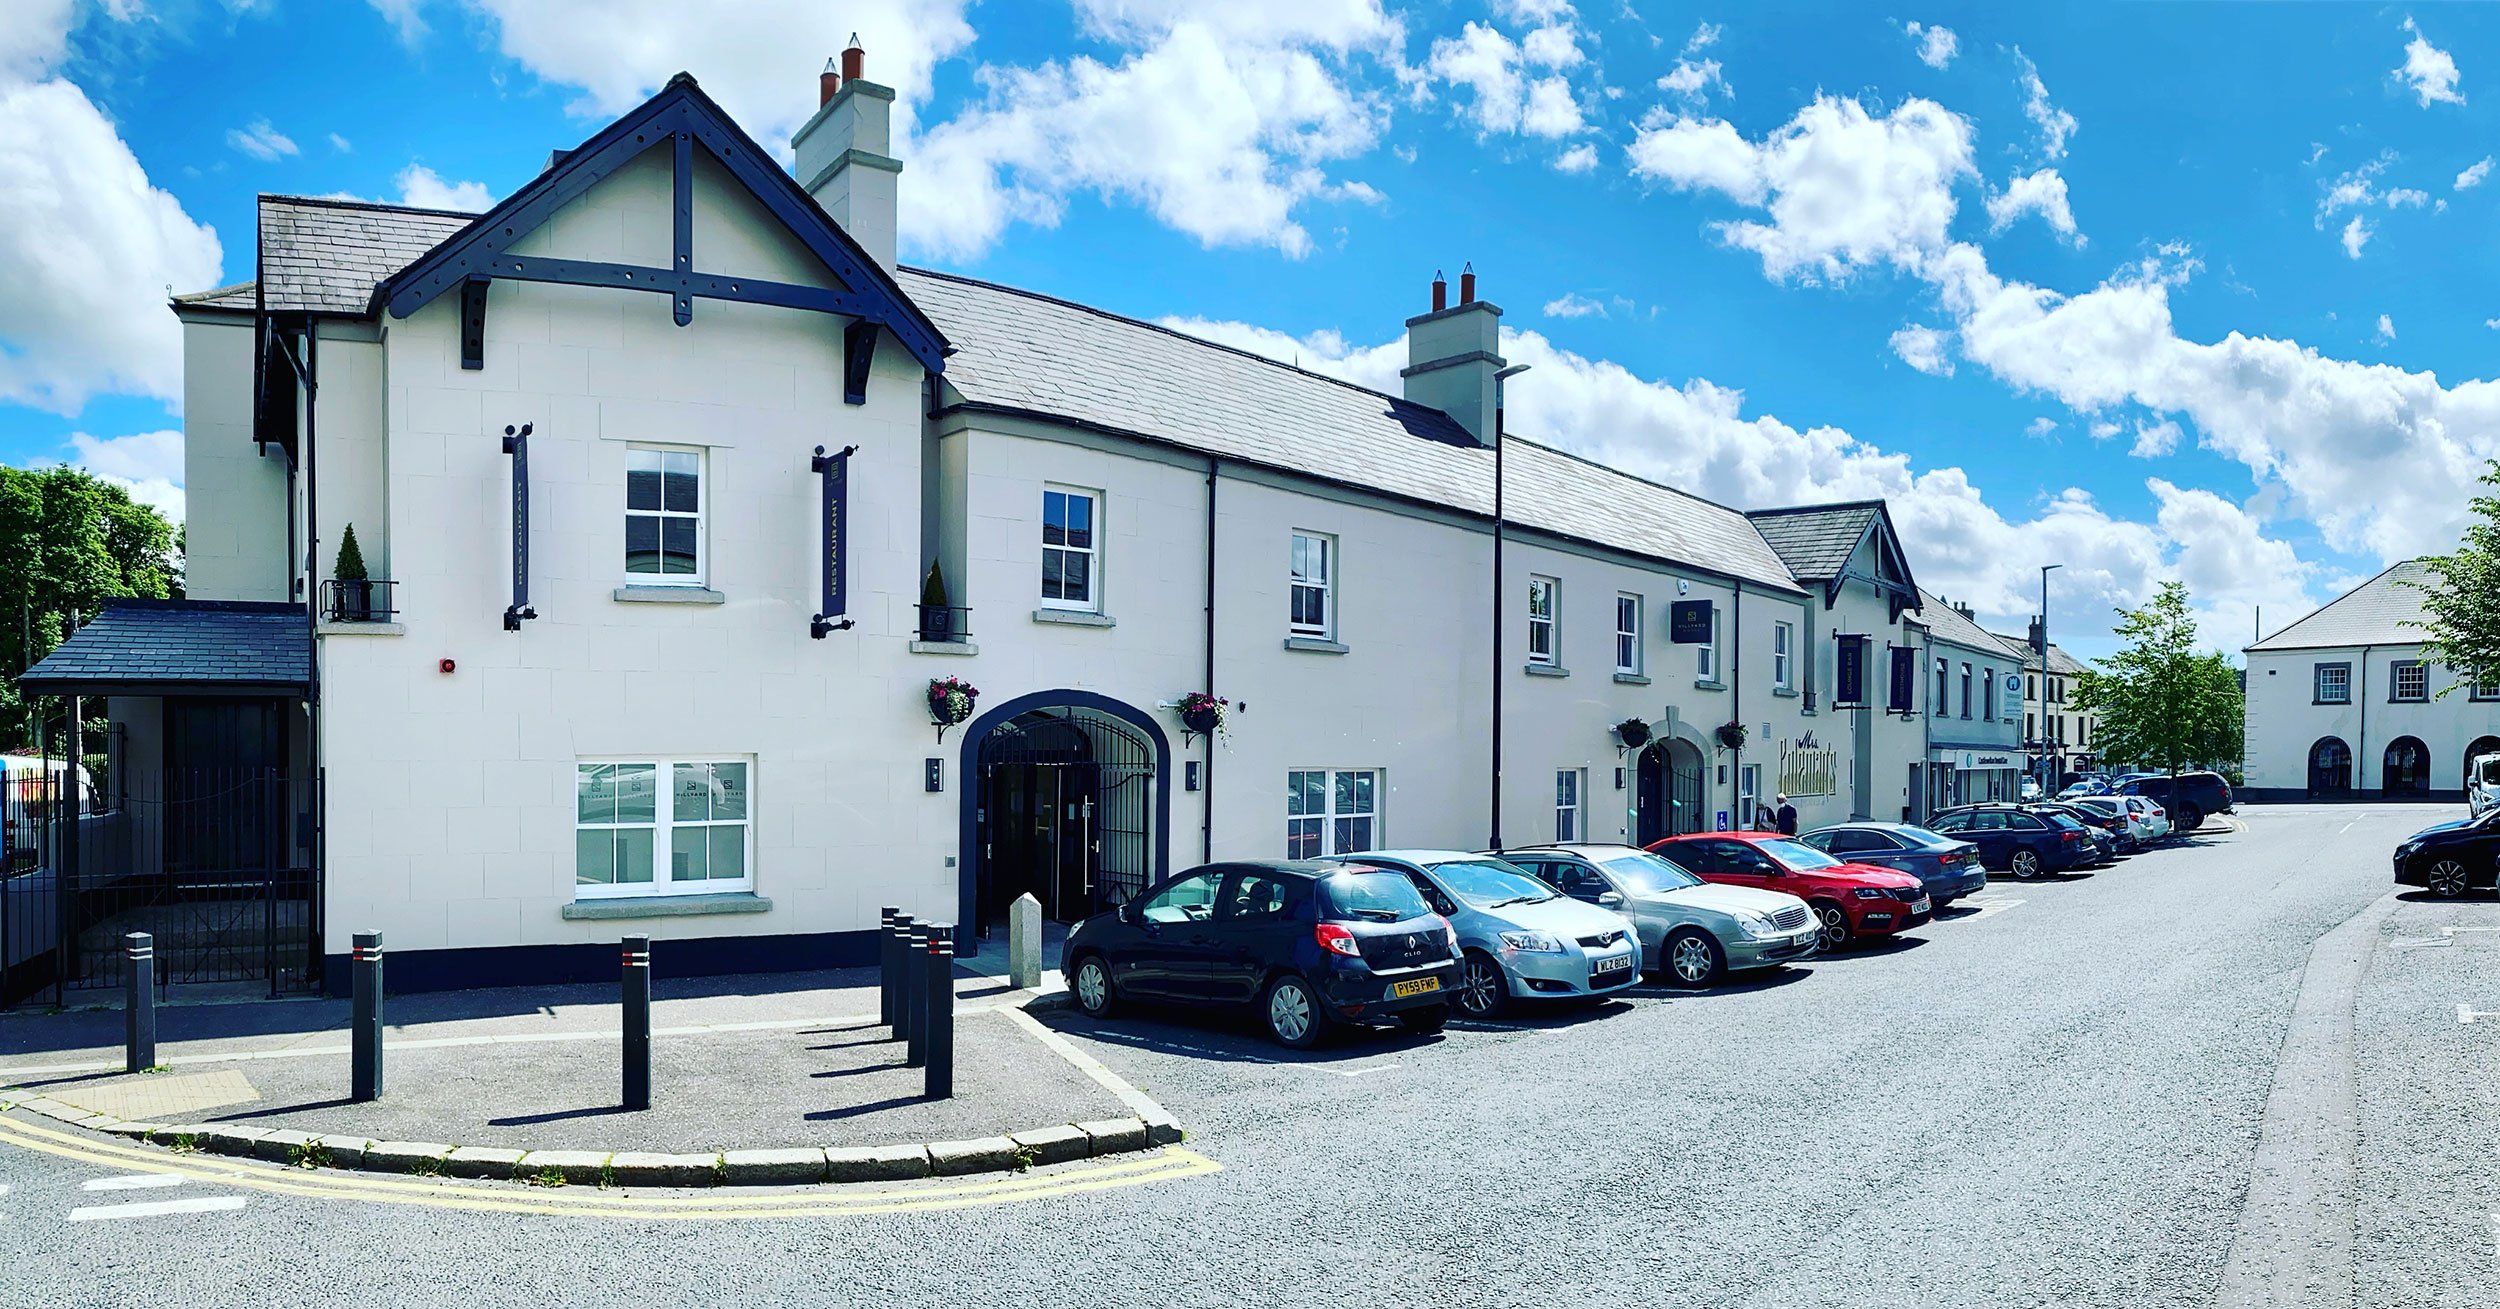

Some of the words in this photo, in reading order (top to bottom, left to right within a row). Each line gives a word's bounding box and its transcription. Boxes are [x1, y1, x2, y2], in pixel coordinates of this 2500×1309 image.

[1404, 950, 1421, 958] CLIO
[1614, 957, 1629, 969] 8132
[1397, 980, 1420, 995] PY59
